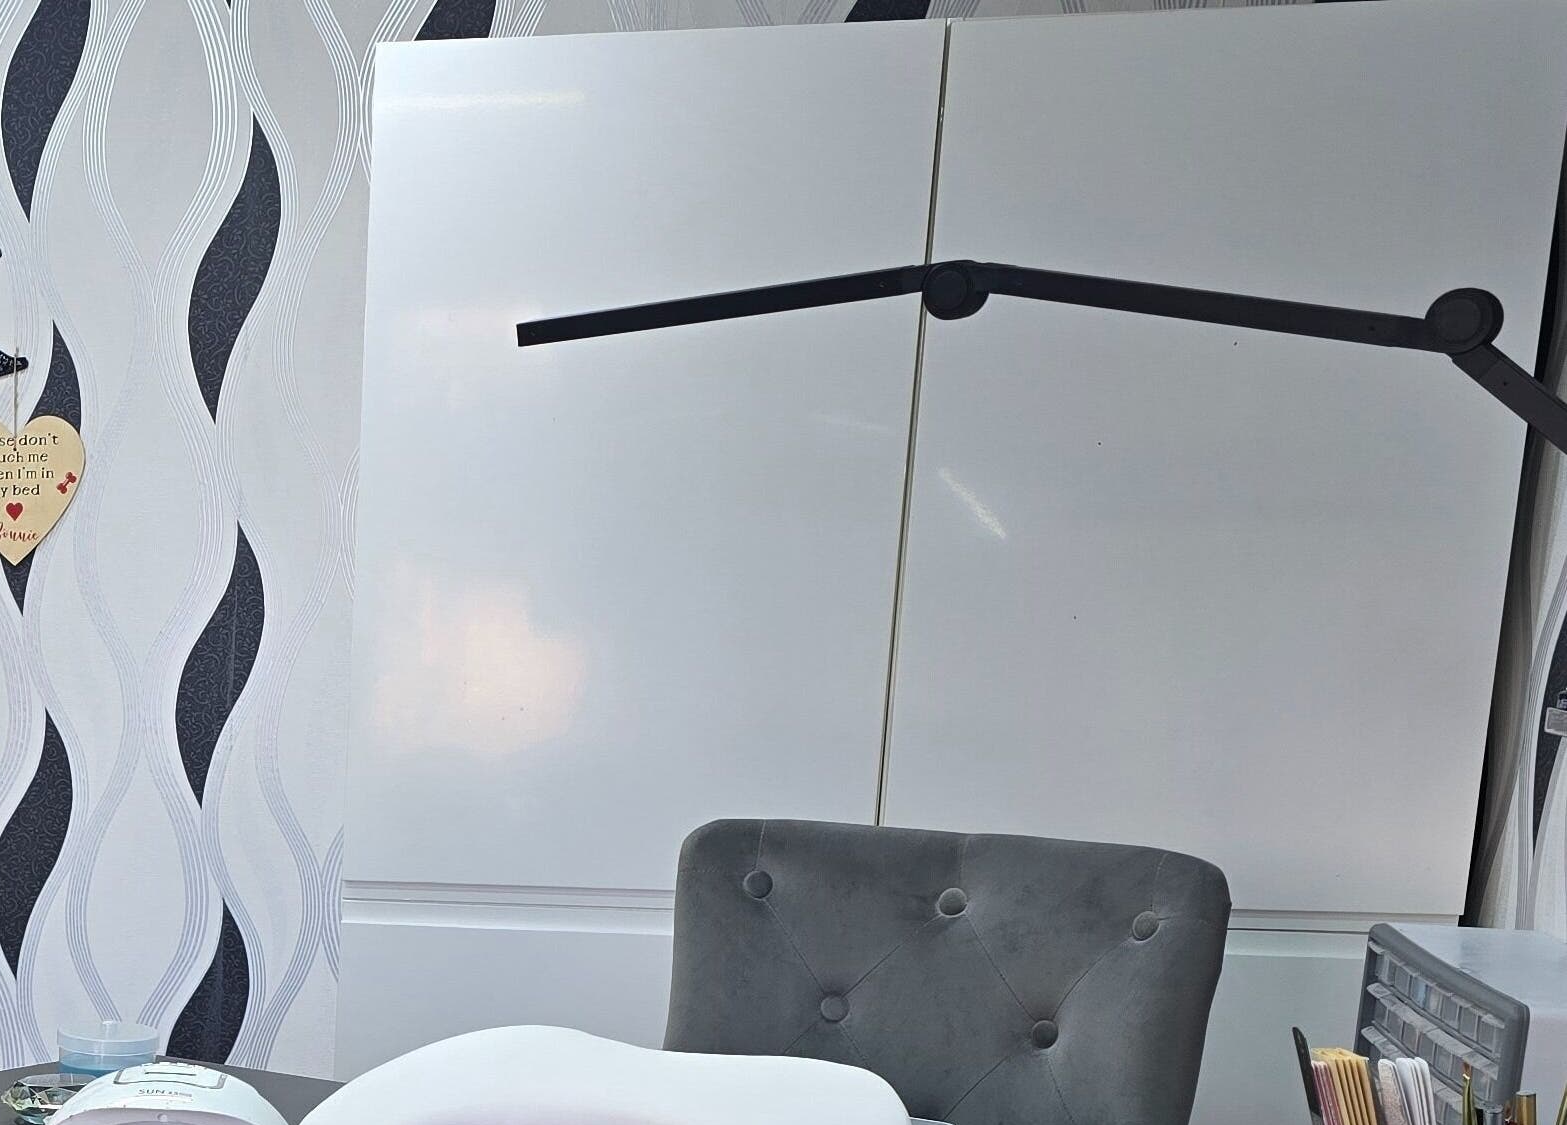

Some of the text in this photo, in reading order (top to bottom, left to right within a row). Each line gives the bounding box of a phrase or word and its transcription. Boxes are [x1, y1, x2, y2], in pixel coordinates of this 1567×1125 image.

[18, 433, 59, 446] don't
[27, 453, 48, 463] me
[17, 467, 37, 479] I'm
[41, 467, 54, 479] in
[12, 484, 40, 496] bed
